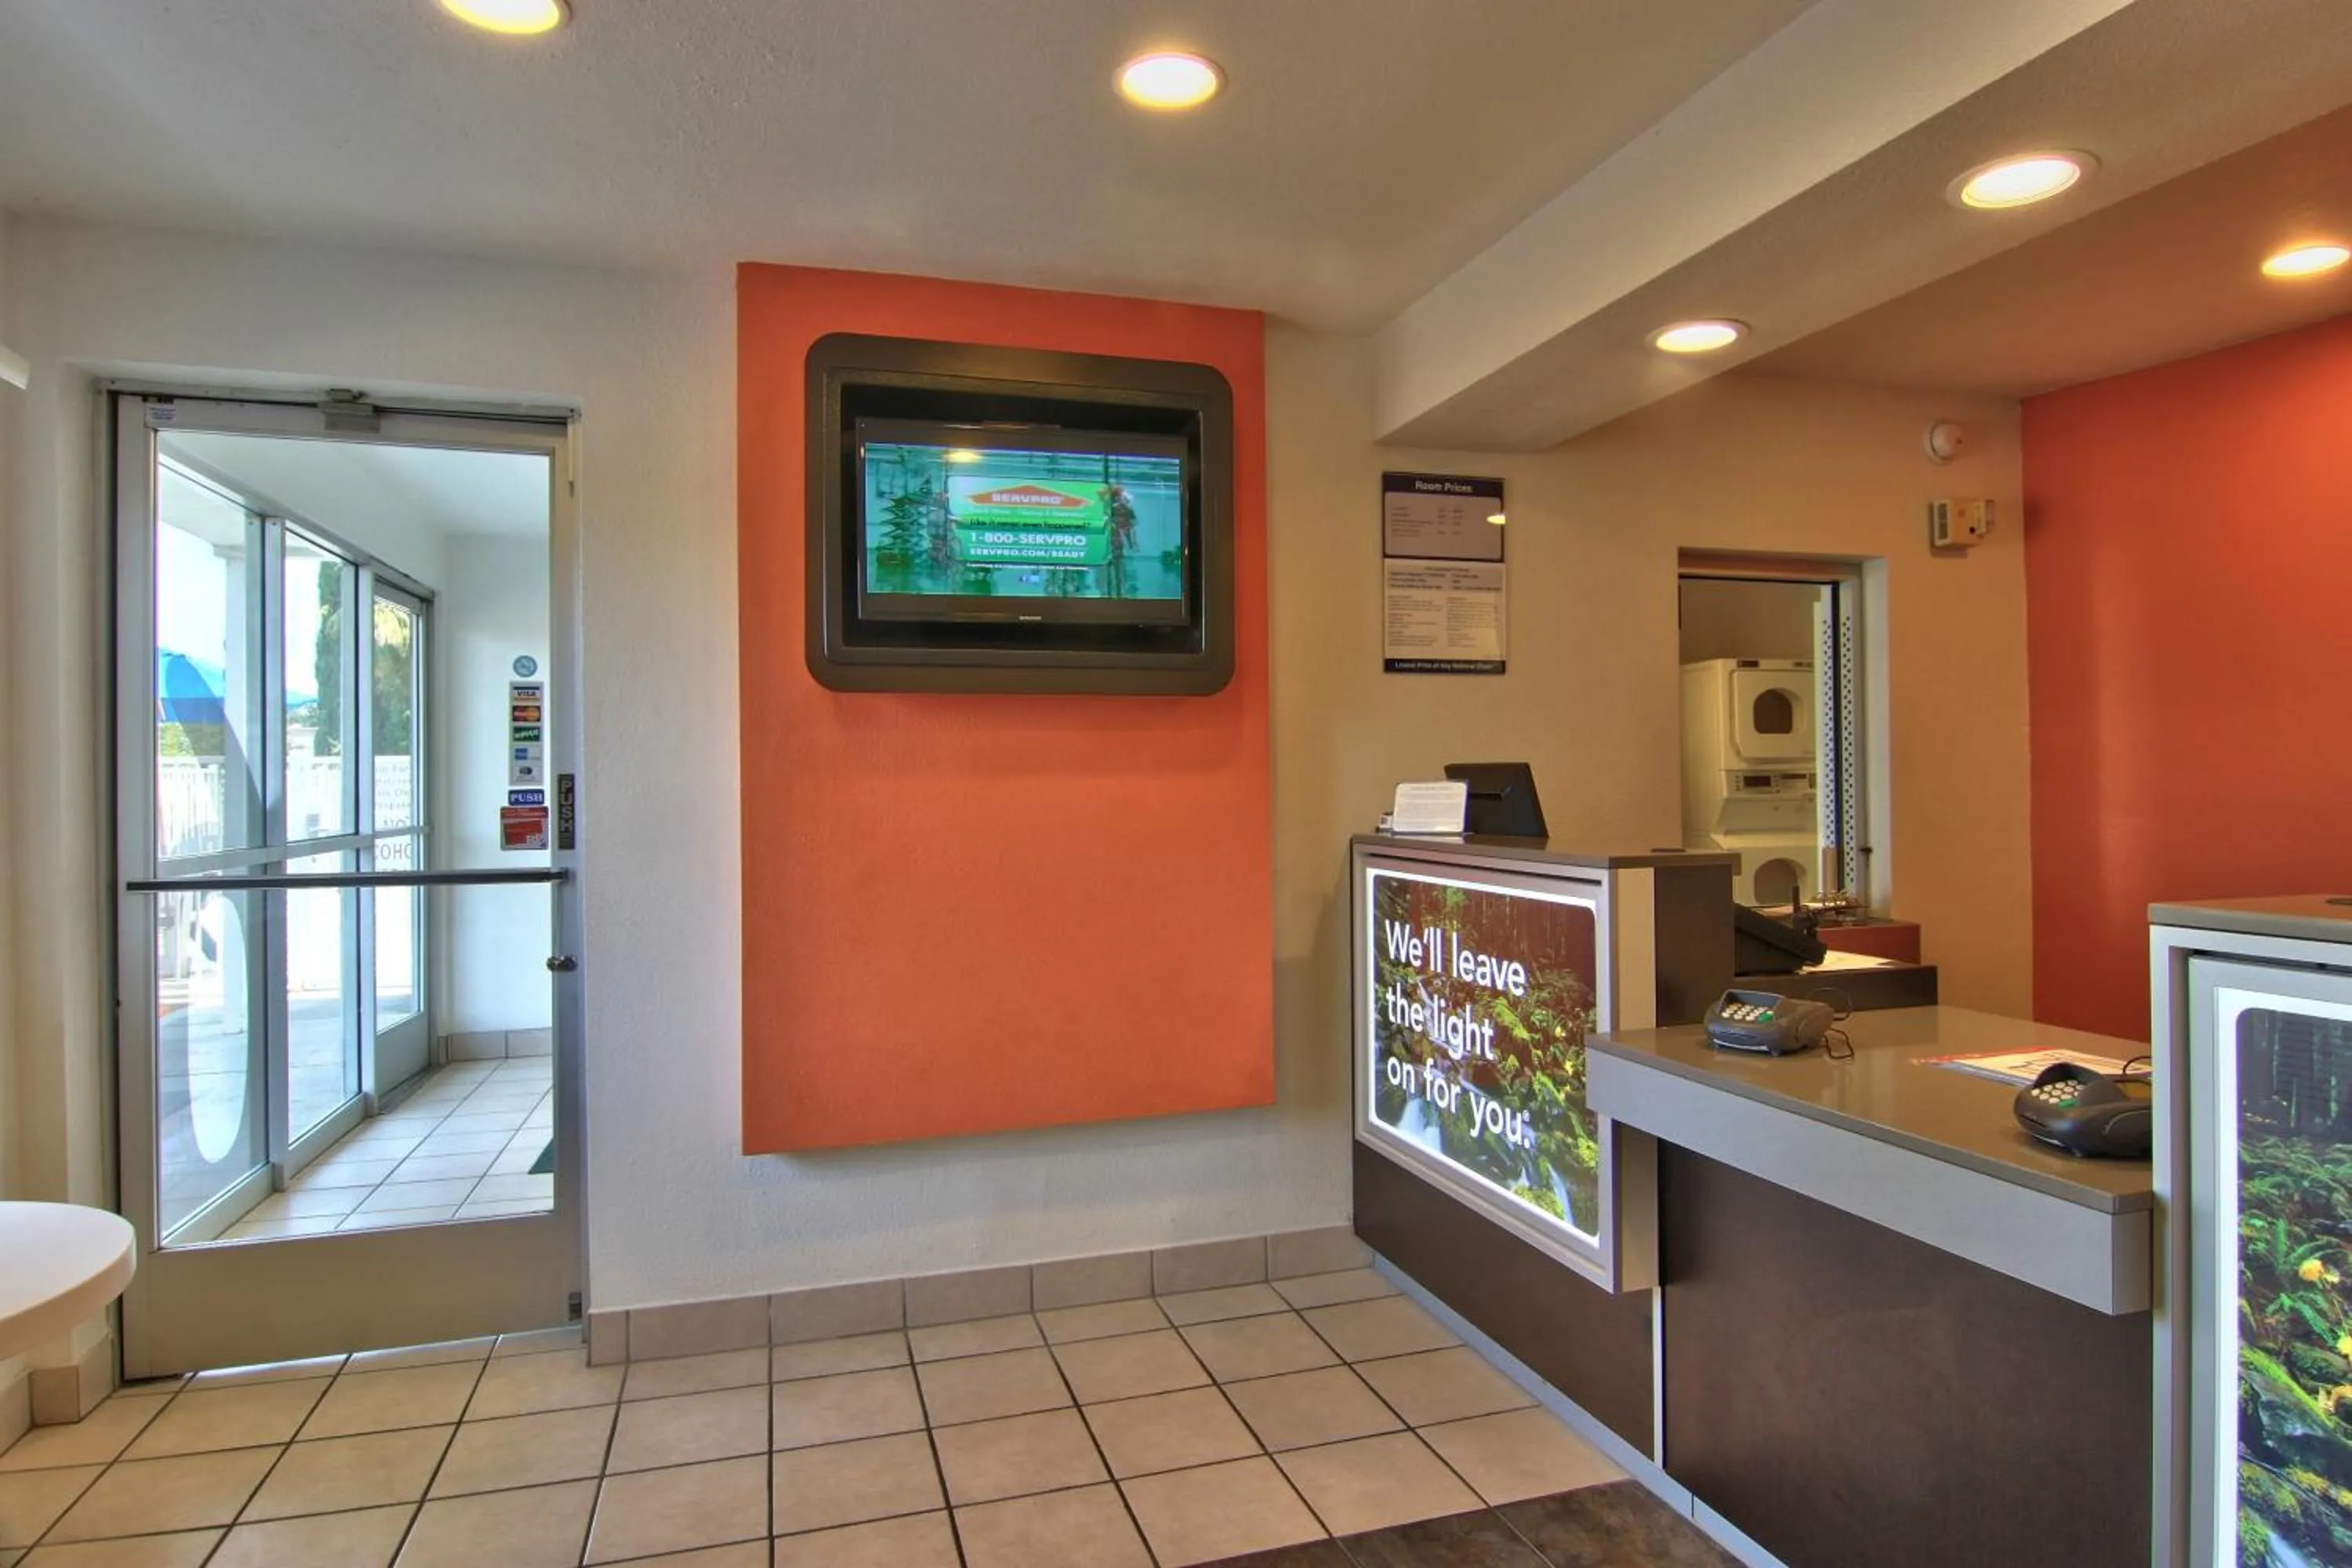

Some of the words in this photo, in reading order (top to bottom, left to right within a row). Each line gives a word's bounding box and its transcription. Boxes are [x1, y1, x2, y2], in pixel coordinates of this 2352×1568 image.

[990, 492, 1062, 504] SERVPRO
[1414, 480, 1442, 491] Room
[1444, 482, 1473, 493] Prices
[970, 532, 1087, 546] 1-800-SERVPRO
[510, 792, 543, 803] PUSH
[560, 779, 573, 832] PUSH
[1385, 919, 1443, 973] We'll
[1451, 931, 1526, 997] leave
[1385, 982, 1425, 1033] the
[1432, 993, 1494, 1061] light
[1387, 1056, 1415, 1094] on
[1423, 1057, 1461, 1113] for
